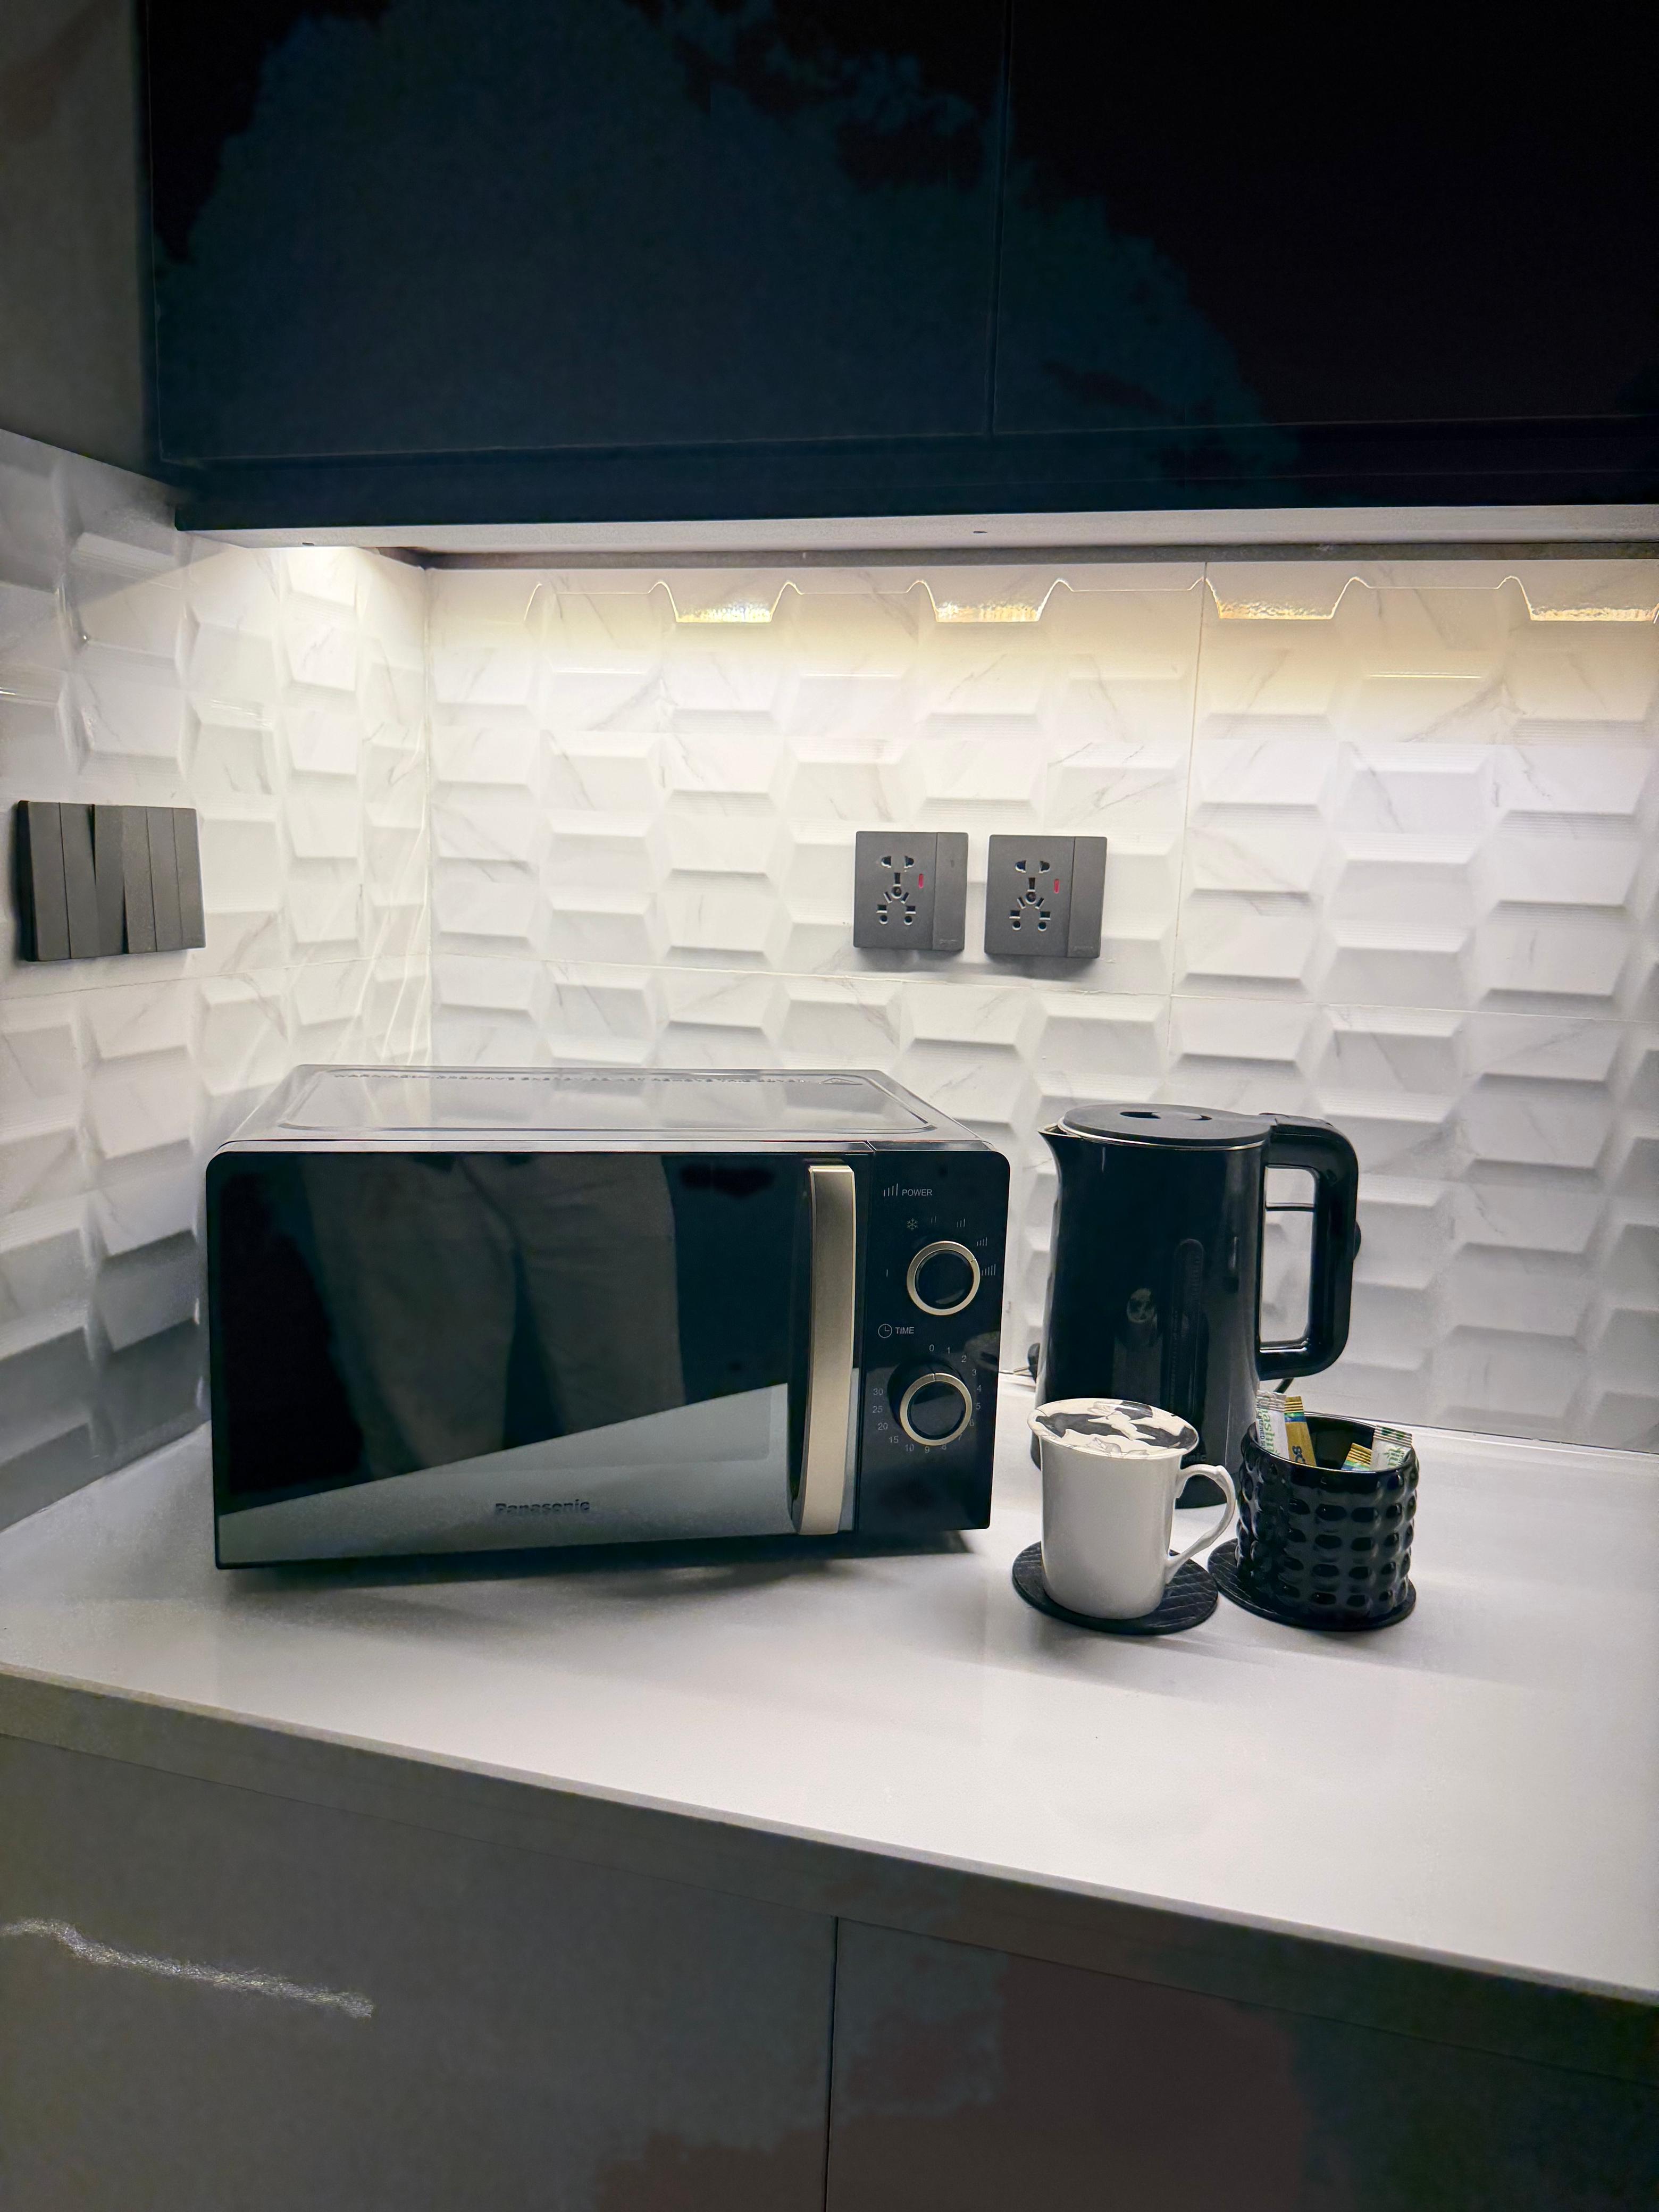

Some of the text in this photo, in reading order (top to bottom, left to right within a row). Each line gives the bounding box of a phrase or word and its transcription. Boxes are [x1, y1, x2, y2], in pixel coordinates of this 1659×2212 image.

[906, 1444, 915, 1452] 10
[925, 1445, 930, 1454] 9
[495, 1498, 590, 1515] Panasonic
